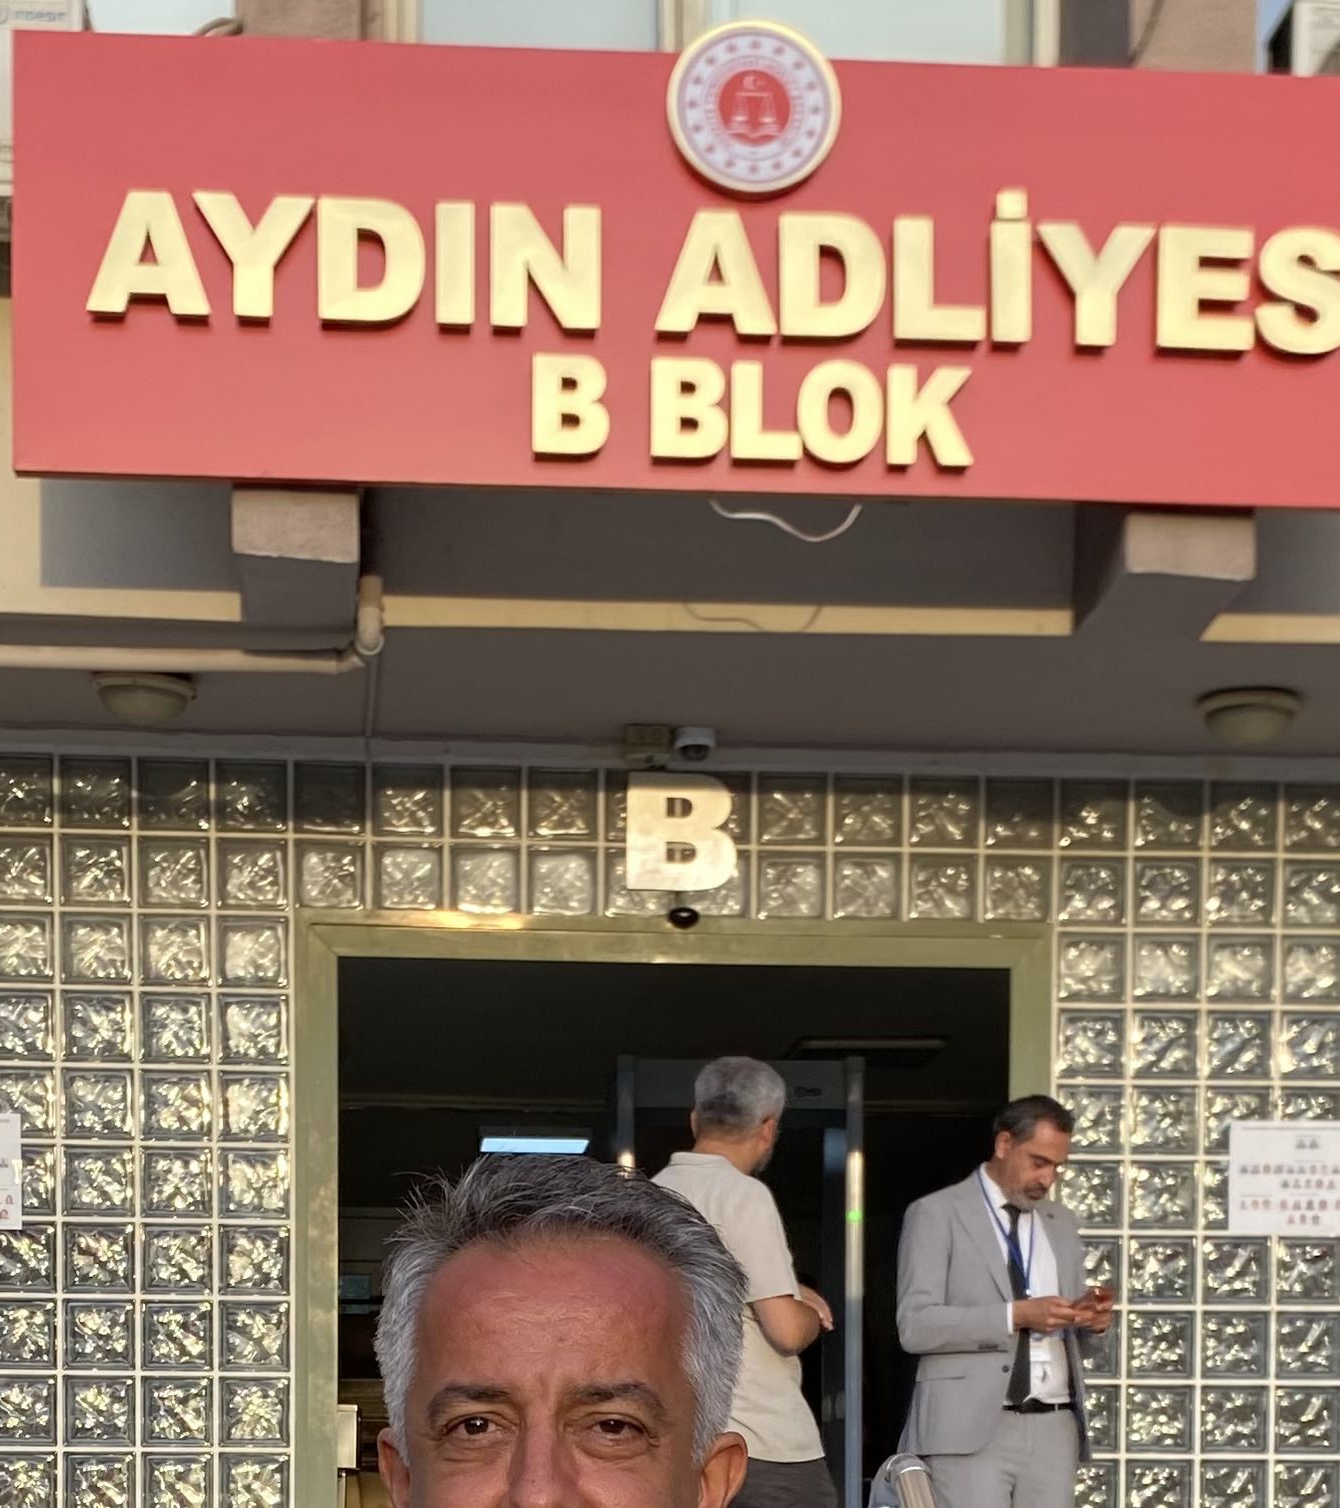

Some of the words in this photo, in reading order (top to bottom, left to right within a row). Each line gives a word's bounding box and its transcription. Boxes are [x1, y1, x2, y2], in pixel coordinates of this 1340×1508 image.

[85, 189, 603, 331] AYDIN
[531, 352, 611, 457] B
[649, 354, 975, 468] BLOK
[626, 772, 737, 891] B
